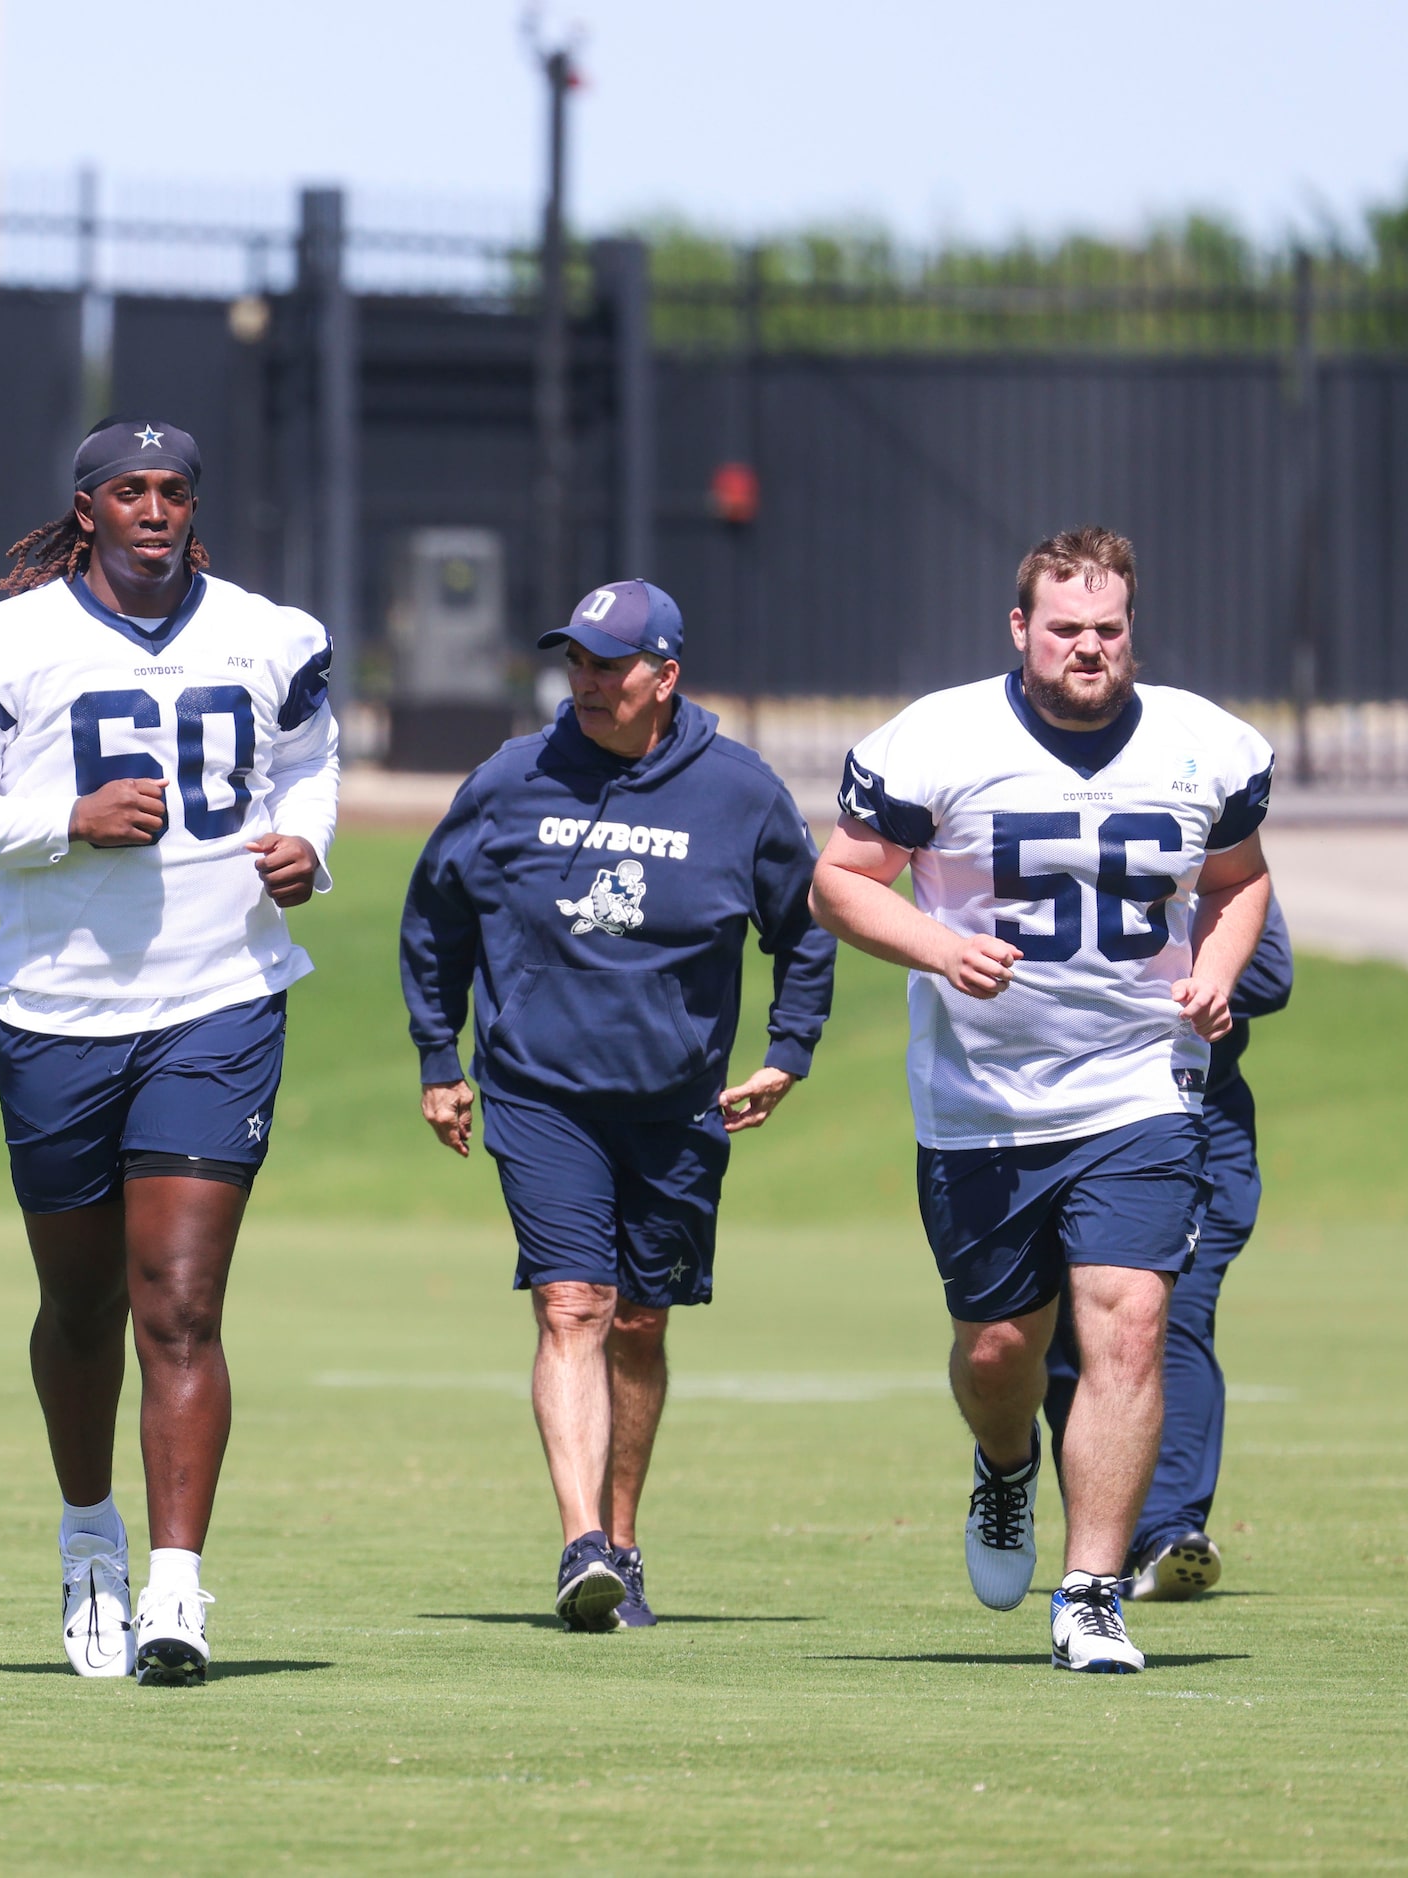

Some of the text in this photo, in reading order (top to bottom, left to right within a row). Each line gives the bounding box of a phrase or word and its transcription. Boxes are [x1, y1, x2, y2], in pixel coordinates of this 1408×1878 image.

[582, 590, 617, 622] D
[134, 666, 184, 676] COWBOYS
[227, 656, 255, 669] AT&T
[71, 685, 256, 849] 60
[1063, 792, 1113, 801] COWBOYS
[1172, 781, 1199, 794] AT&T
[538, 816, 689, 860] COWBOYS
[992, 812, 1182, 962] 56
